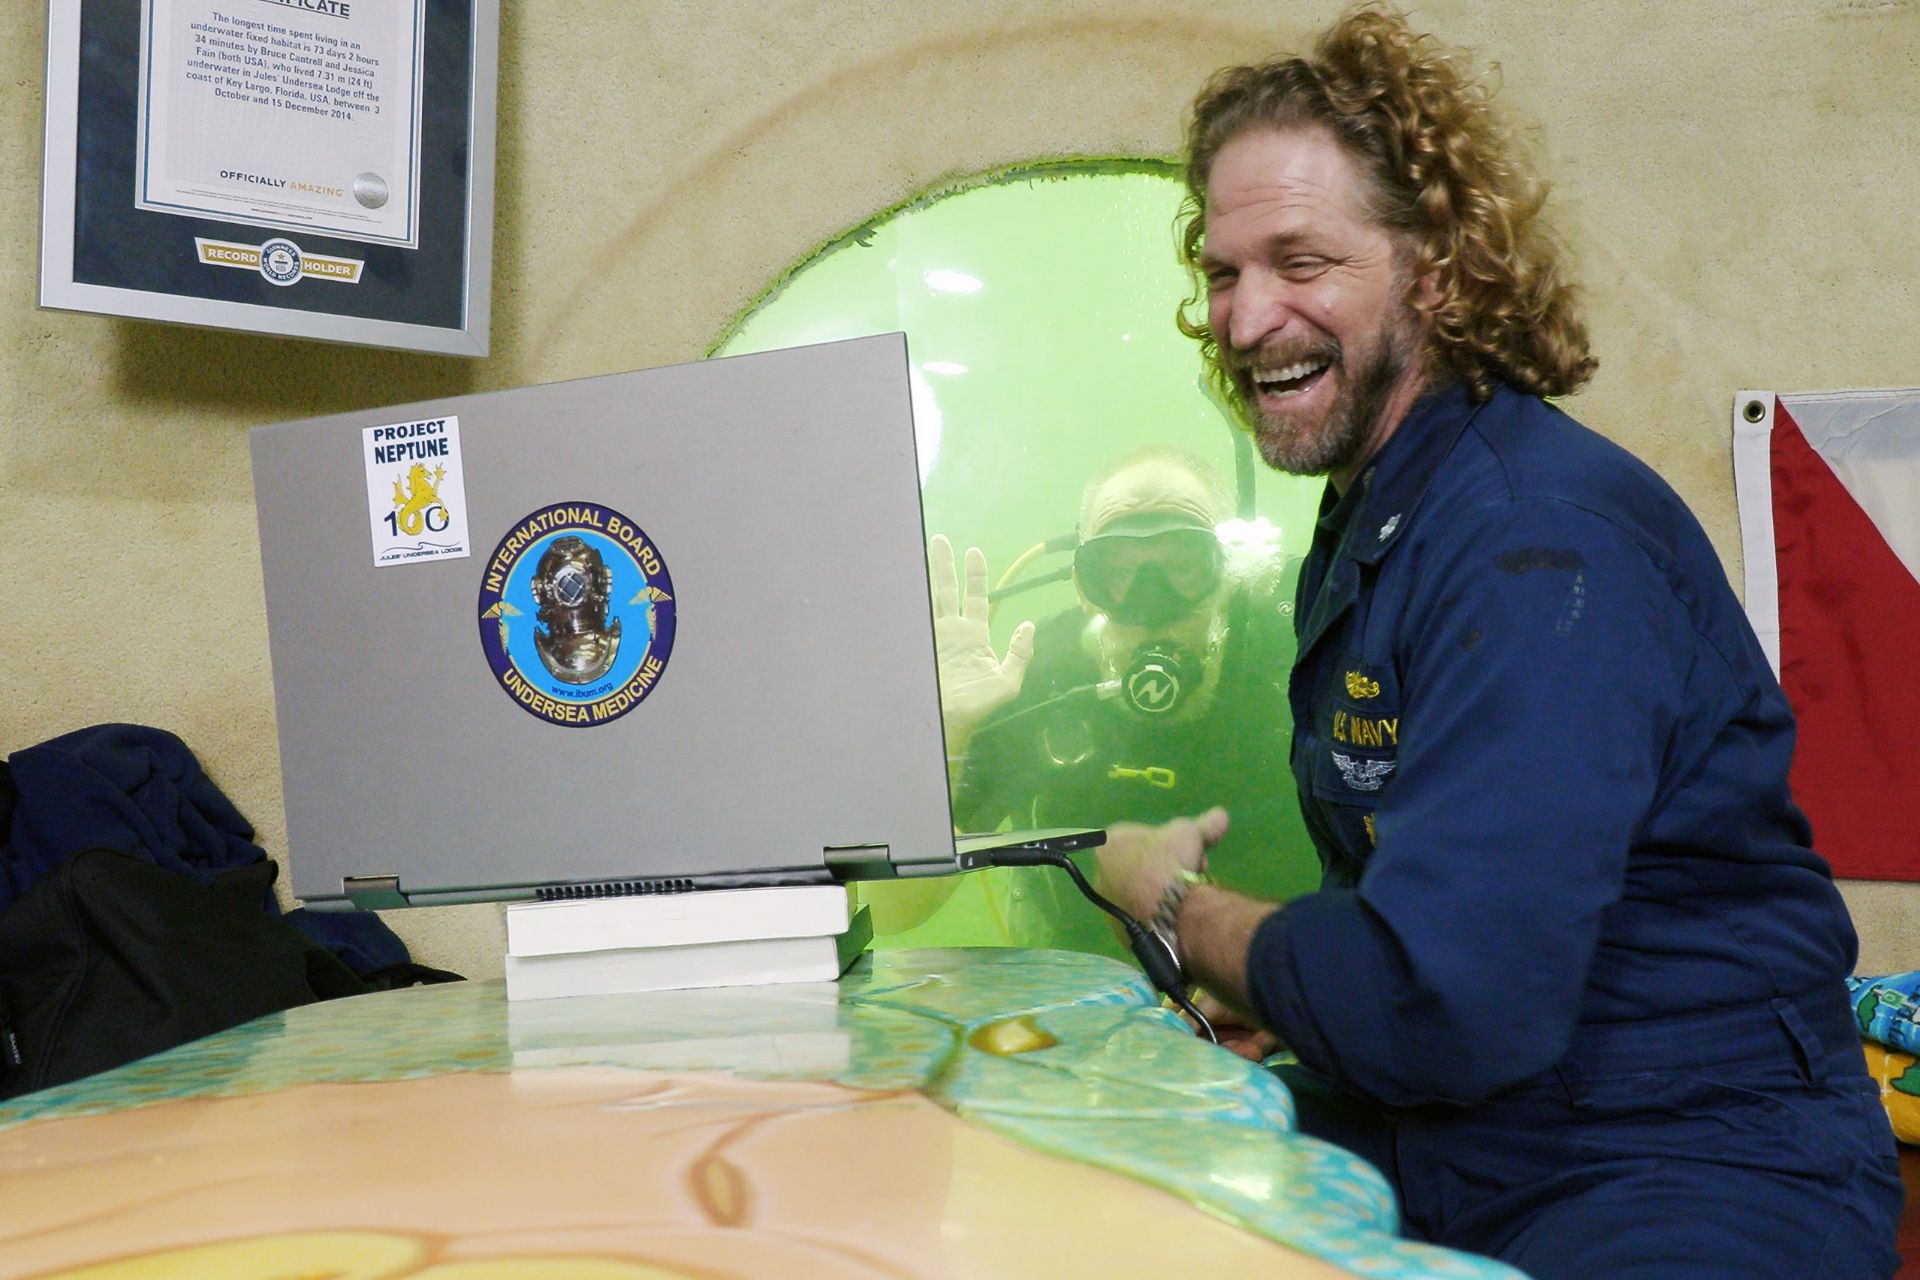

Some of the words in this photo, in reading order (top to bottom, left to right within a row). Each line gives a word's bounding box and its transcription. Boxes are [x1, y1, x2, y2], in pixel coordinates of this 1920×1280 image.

[190, 22, 243, 38] underwater
[246, 31, 268, 43] fixed
[271, 37, 301, 50] habitat
[303, 43, 311, 52] is
[314, 45, 324, 54] 73
[326, 47, 346, 60] days
[348, 52, 354, 61] 2
[356, 54, 379, 66] hours
[212, 12, 229, 23] The
[232, 16, 265, 30] longest
[267, 24, 286, 35] time
[289, 29, 313, 41] spent
[315, 34, 338, 46] living
[340, 38, 347, 47] in
[350, 42, 360, 50] an
[195, 34, 206, 43] 34
[209, 38, 245, 51] minutes
[247, 44, 258, 55] by
[261, 47, 287, 60] Bruce
[289, 52, 323, 67] Cantrell
[324, 61, 340, 71] and
[342, 64, 375, 77] Jessica
[196, 46, 215, 58] Fain
[218, 50, 241, 63] (both
[272, 62, 291, 73] who
[294, 65, 315, 77] lived
[317, 70, 334, 81] 7.31
[337, 75, 346, 83] m
[348, 76, 360, 87] (24
[363, 79, 373, 90] ft)
[186, 71, 212, 83] coast
[214, 75, 223, 85] of
[226, 77, 243, 89] Key
[333, 98, 370, 112] between
[374, 105, 380, 114] 3
[187, 59, 240, 75] underwater
[242, 67, 251, 77] in
[282, 75, 323, 91] Undersea
[325, 84, 351, 97] Lodge
[353, 89, 365, 100] off
[366, 92, 379, 102] the
[215, 87, 250, 102] October
[253, 96, 269, 105] and
[271, 98, 282, 107] 15
[285, 100, 328, 116] December
[330, 110, 354, 121] 2014.
[220, 170, 286, 188] OFFICIALLY
[289, 182, 344, 197] AMAZING
[207, 248, 258, 263] RECORD
[304, 261, 351, 275] HOLDER
[373, 420, 446, 442] PROJECT
[374, 437, 449, 465] NEPTUNE
[485, 507, 603, 594] INTERNATIONAL
[606, 514, 661, 576] BOARD
[503, 668, 590, 723] UNDERSEA
[593, 655, 663, 721] MEDICINE
[551, 682, 614, 699] www.ibum.org
[1350, 717, 1398, 747] NAVY
